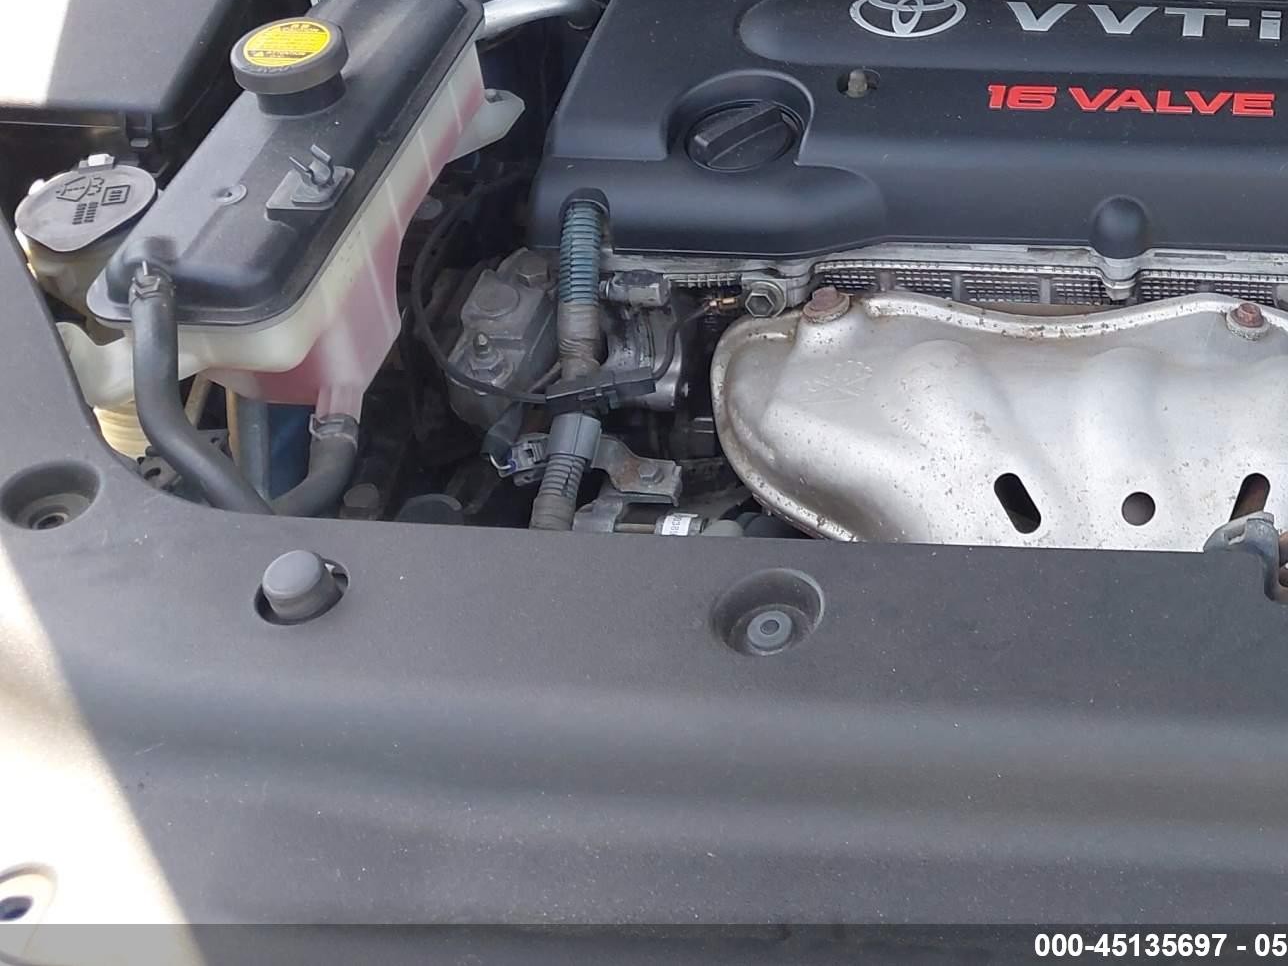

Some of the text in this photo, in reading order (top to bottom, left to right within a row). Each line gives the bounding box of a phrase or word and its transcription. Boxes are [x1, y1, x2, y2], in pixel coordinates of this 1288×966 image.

[1006, 1, 1282, 40] VVT-i
[987, 84, 1276, 117] 16 VALVE
